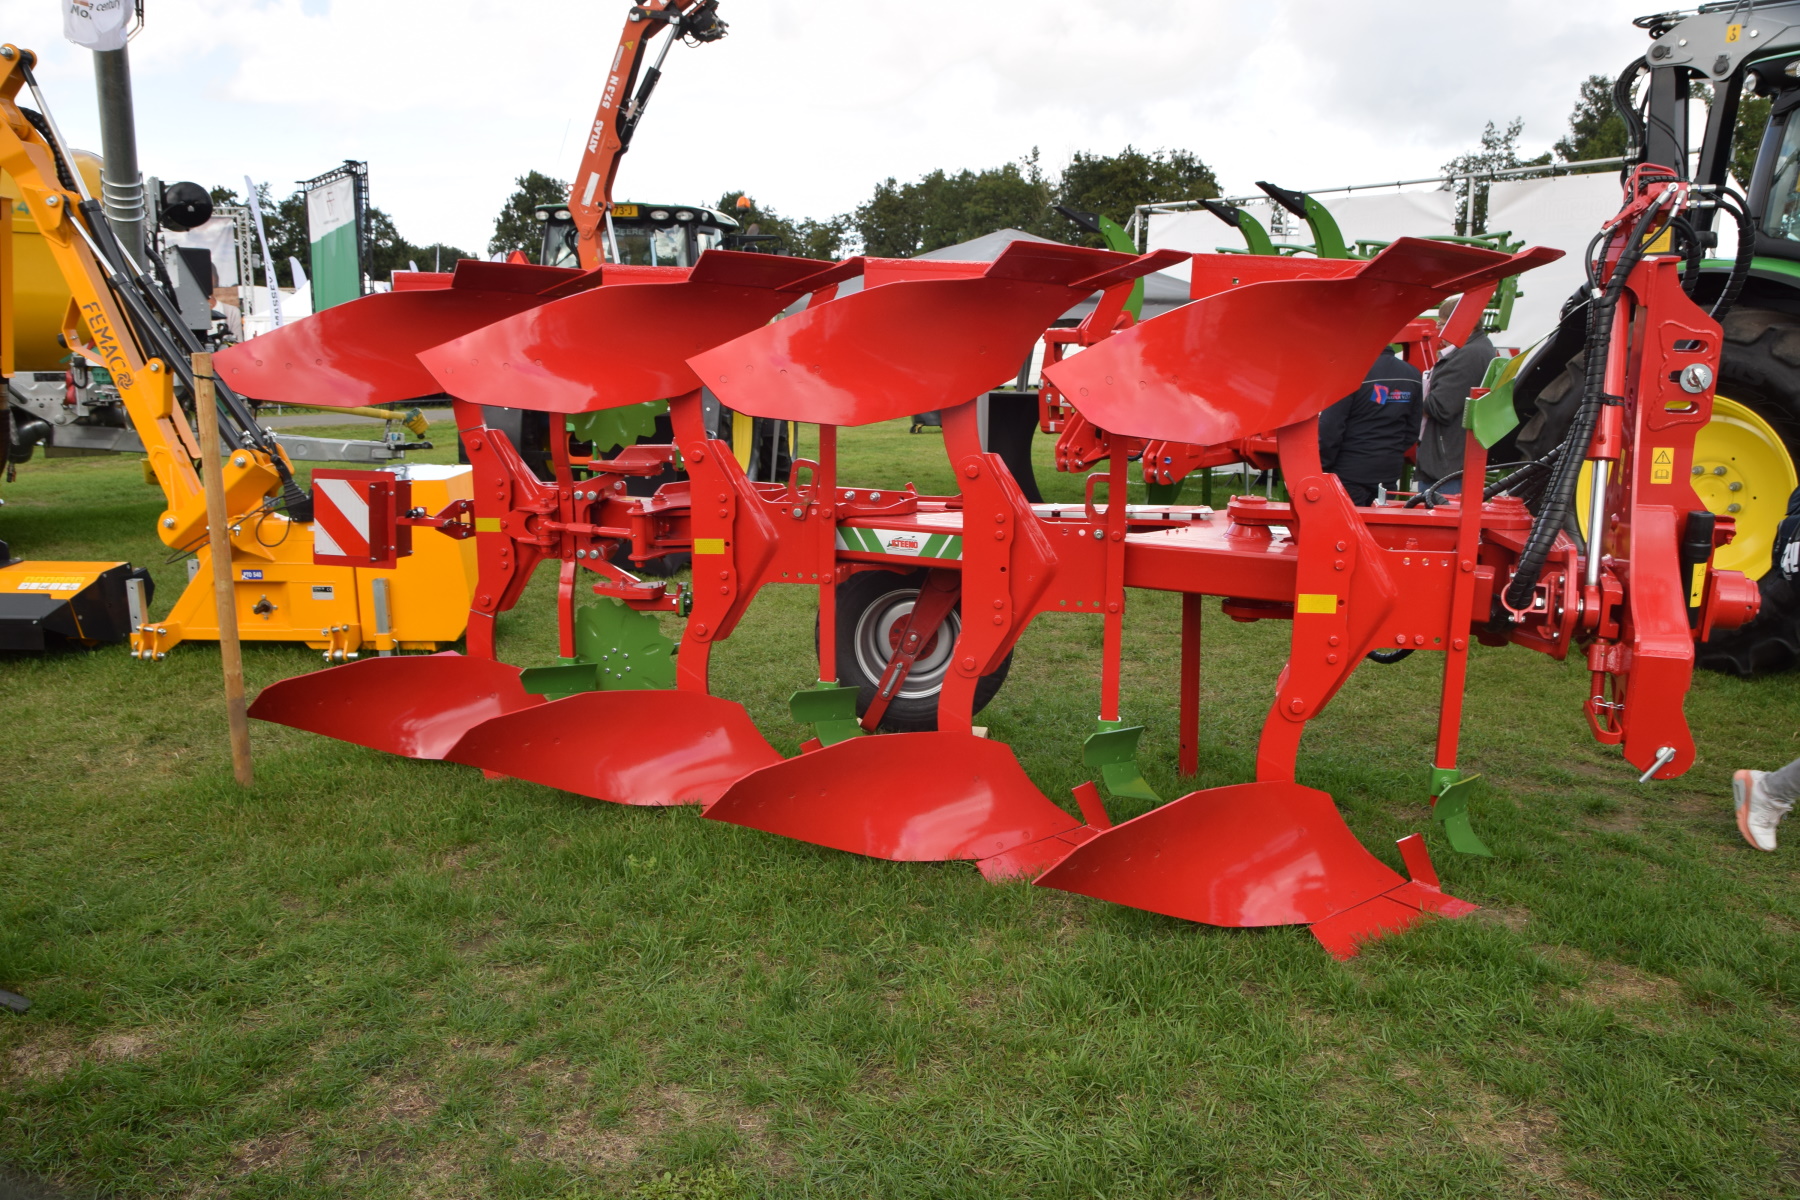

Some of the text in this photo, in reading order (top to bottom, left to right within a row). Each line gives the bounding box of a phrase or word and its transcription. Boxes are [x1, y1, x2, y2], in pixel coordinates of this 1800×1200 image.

[588, 119, 604, 154] ATLAS
[602, 85, 616, 109] 57.3
[610, 75, 620, 86] N
[82, 301, 127, 372] FEMAC
